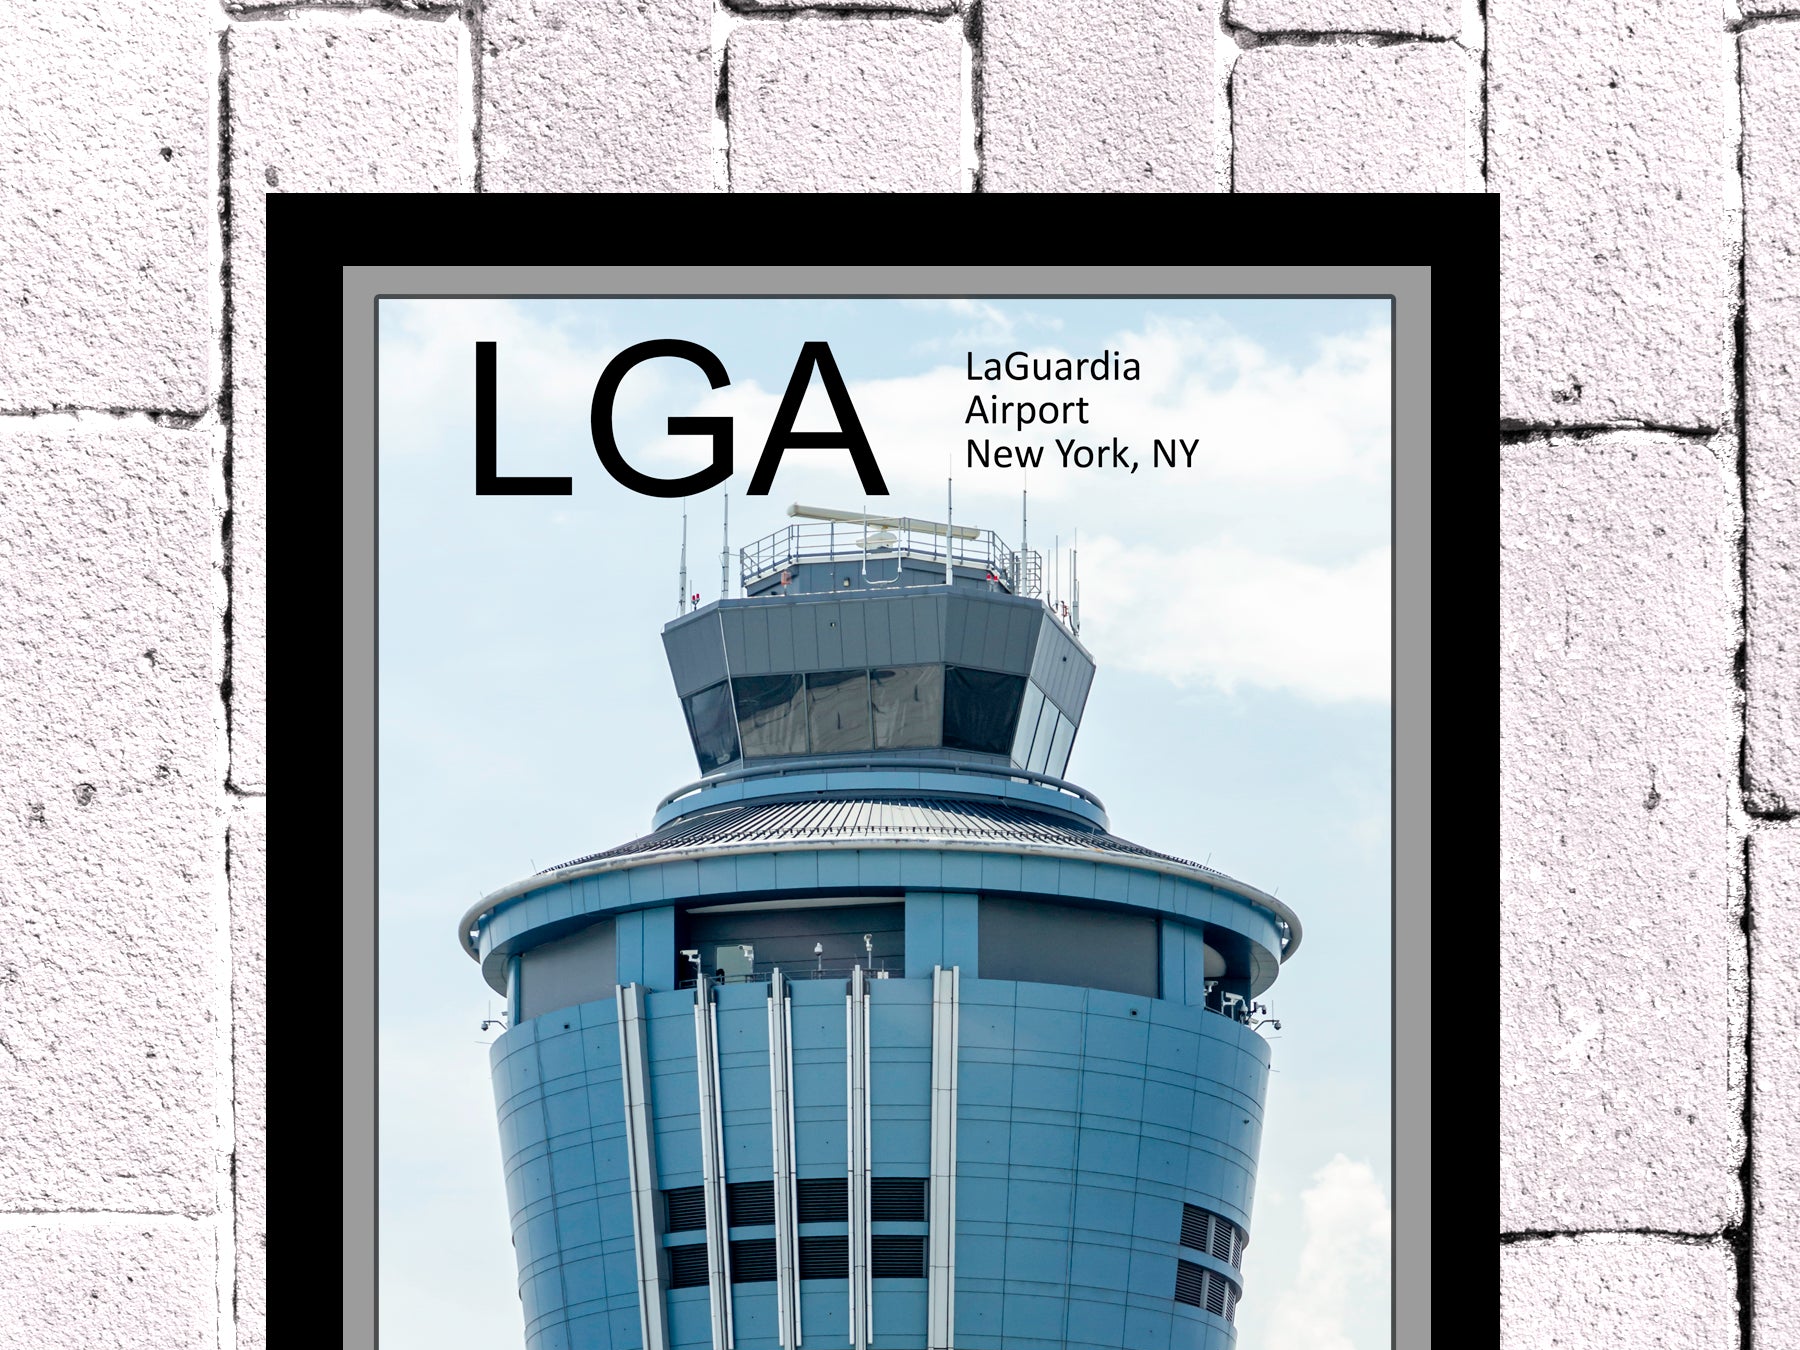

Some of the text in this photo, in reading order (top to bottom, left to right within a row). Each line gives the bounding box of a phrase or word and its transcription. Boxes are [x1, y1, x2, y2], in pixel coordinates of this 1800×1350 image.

[967, 350, 1141, 382] LaGuardia
[475, 338, 890, 498] LGA
[964, 394, 1090, 432] Airport
[967, 437, 1200, 474] New York, NY
